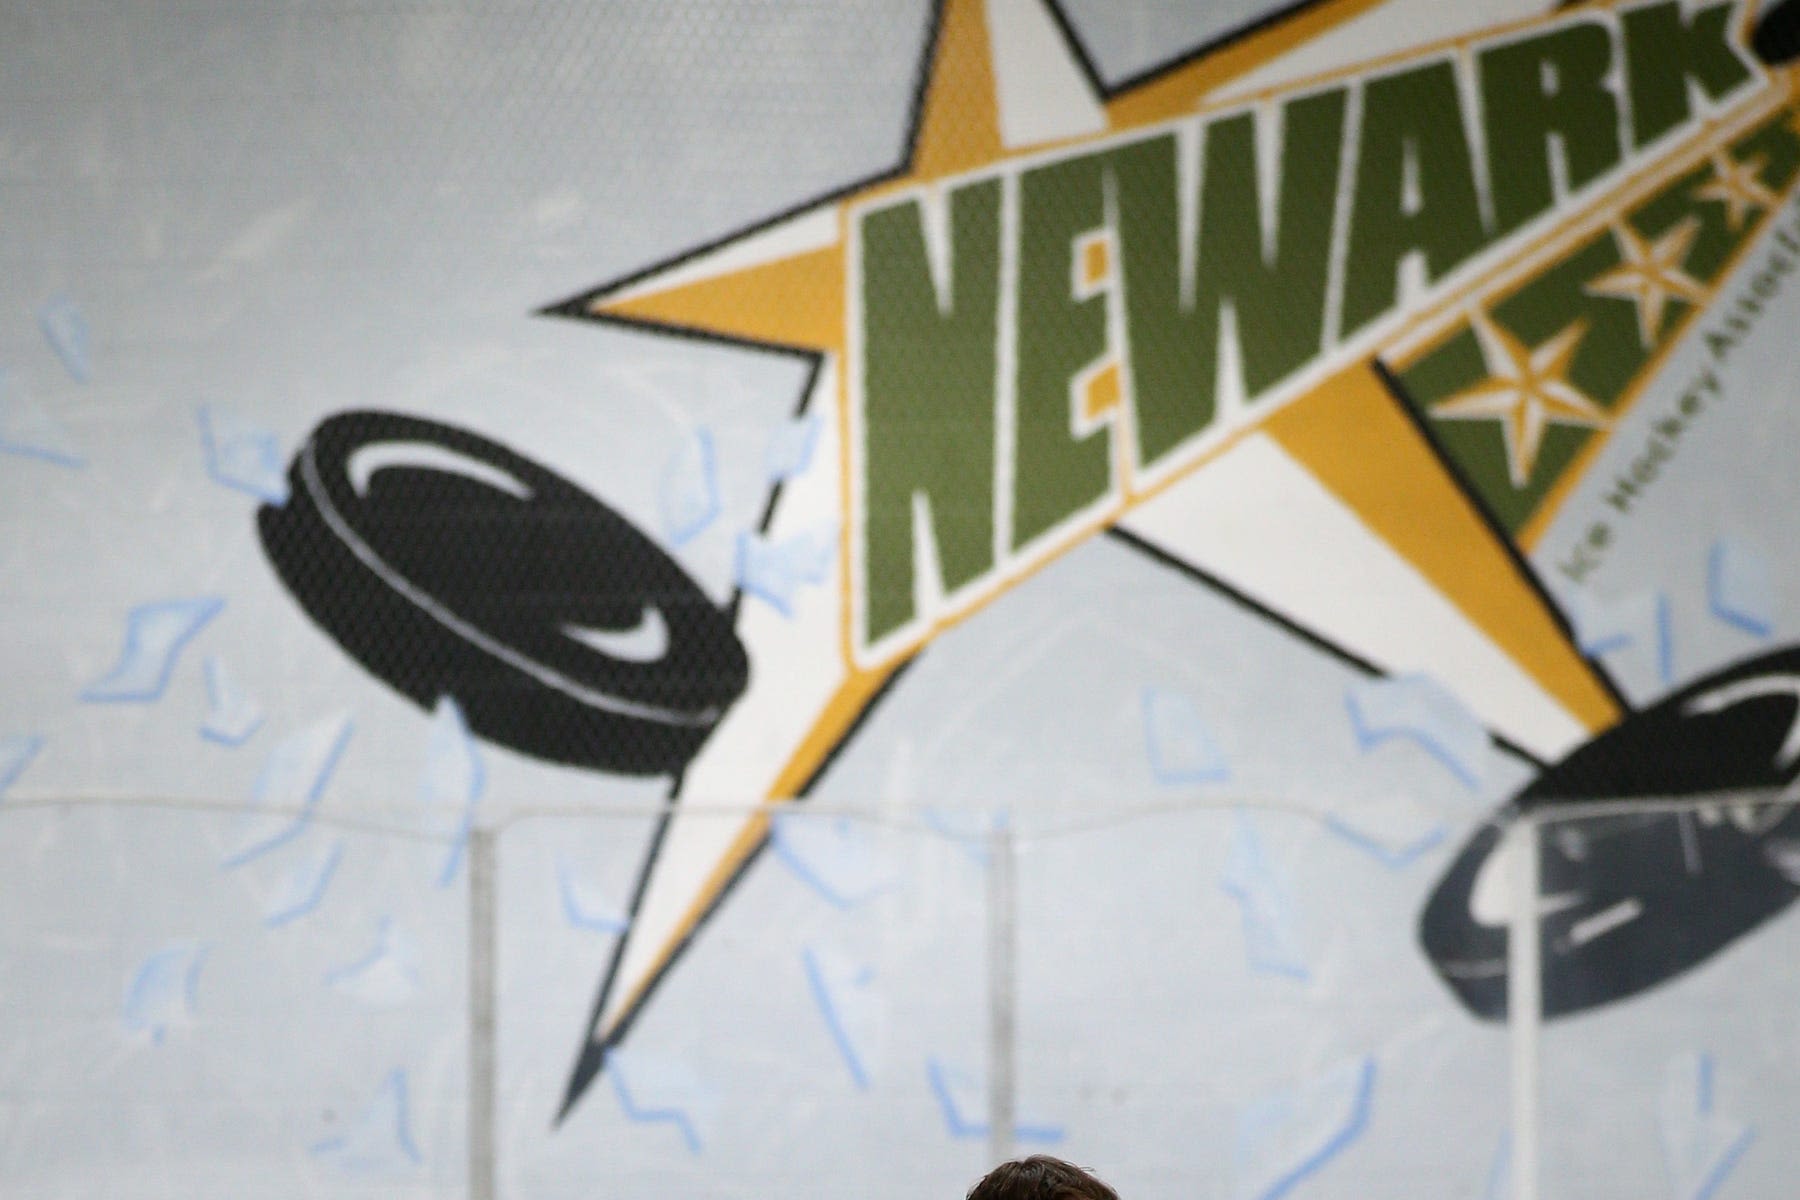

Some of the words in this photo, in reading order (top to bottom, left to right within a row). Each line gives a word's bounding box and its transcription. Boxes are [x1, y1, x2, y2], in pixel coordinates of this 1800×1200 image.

[861, 0, 1752, 645] NEWARK
[1557, 519, 1613, 585] Ice
[1604, 372, 1723, 513] Hockey
[1703, 194, 1800, 362] Associ
